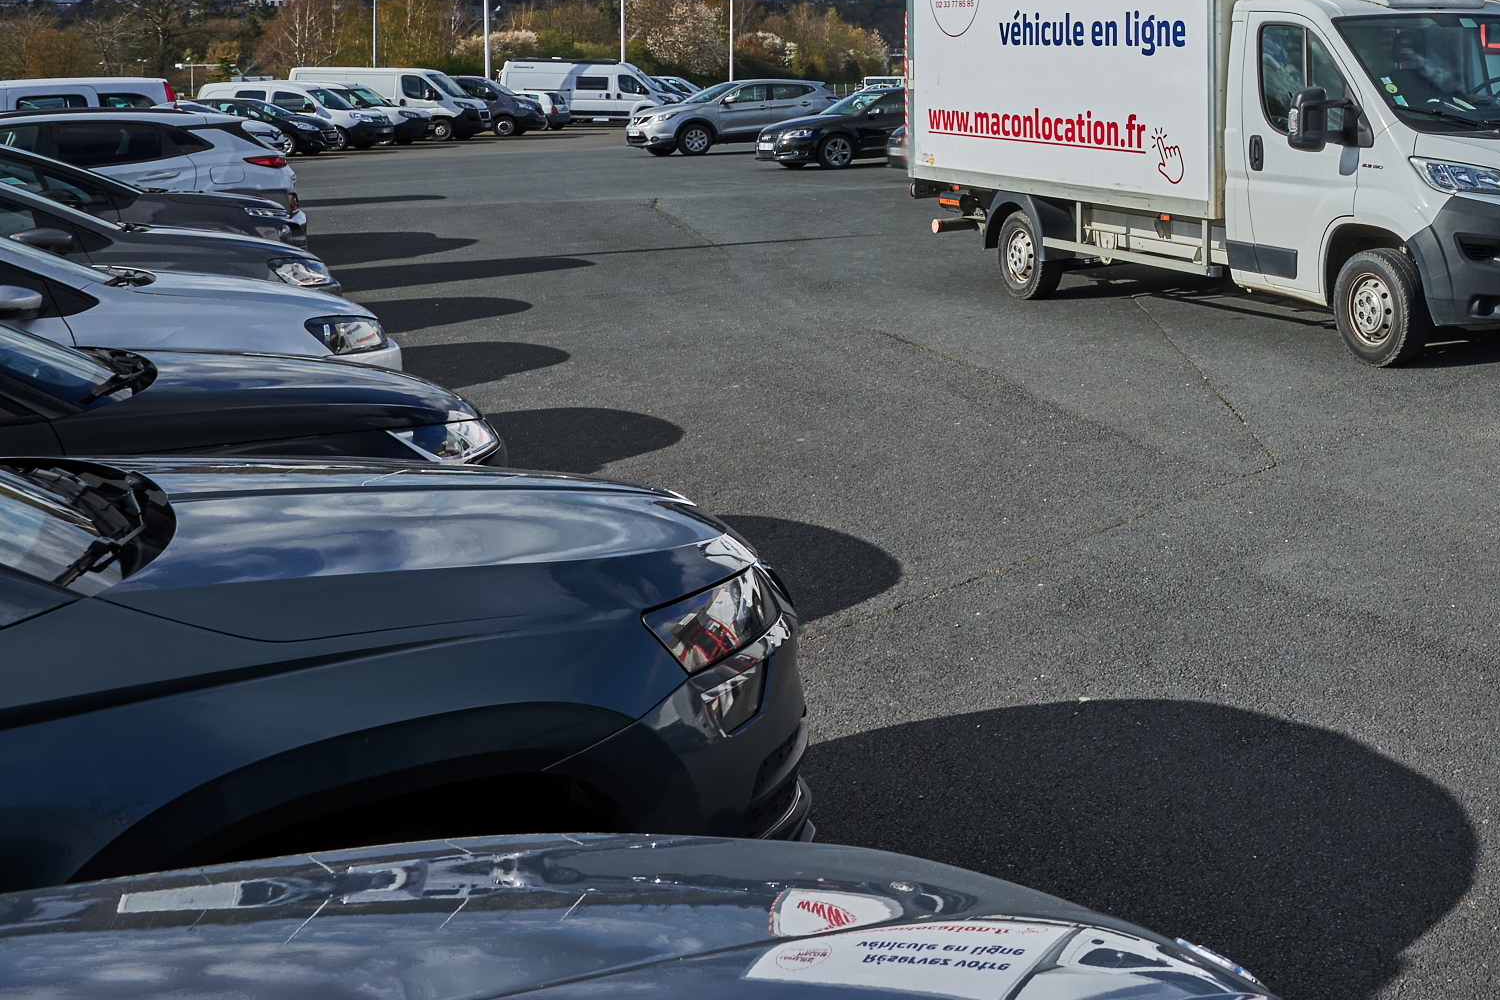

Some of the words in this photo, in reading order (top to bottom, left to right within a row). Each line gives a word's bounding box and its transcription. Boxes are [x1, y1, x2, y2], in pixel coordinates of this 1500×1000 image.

[999, 10, 1084, 46] véhicule
[1091, 20, 1117, 46] en
[1125, 10, 1186, 56] ligne
[928, 108, 1146, 149] www.maconlocation.fr
